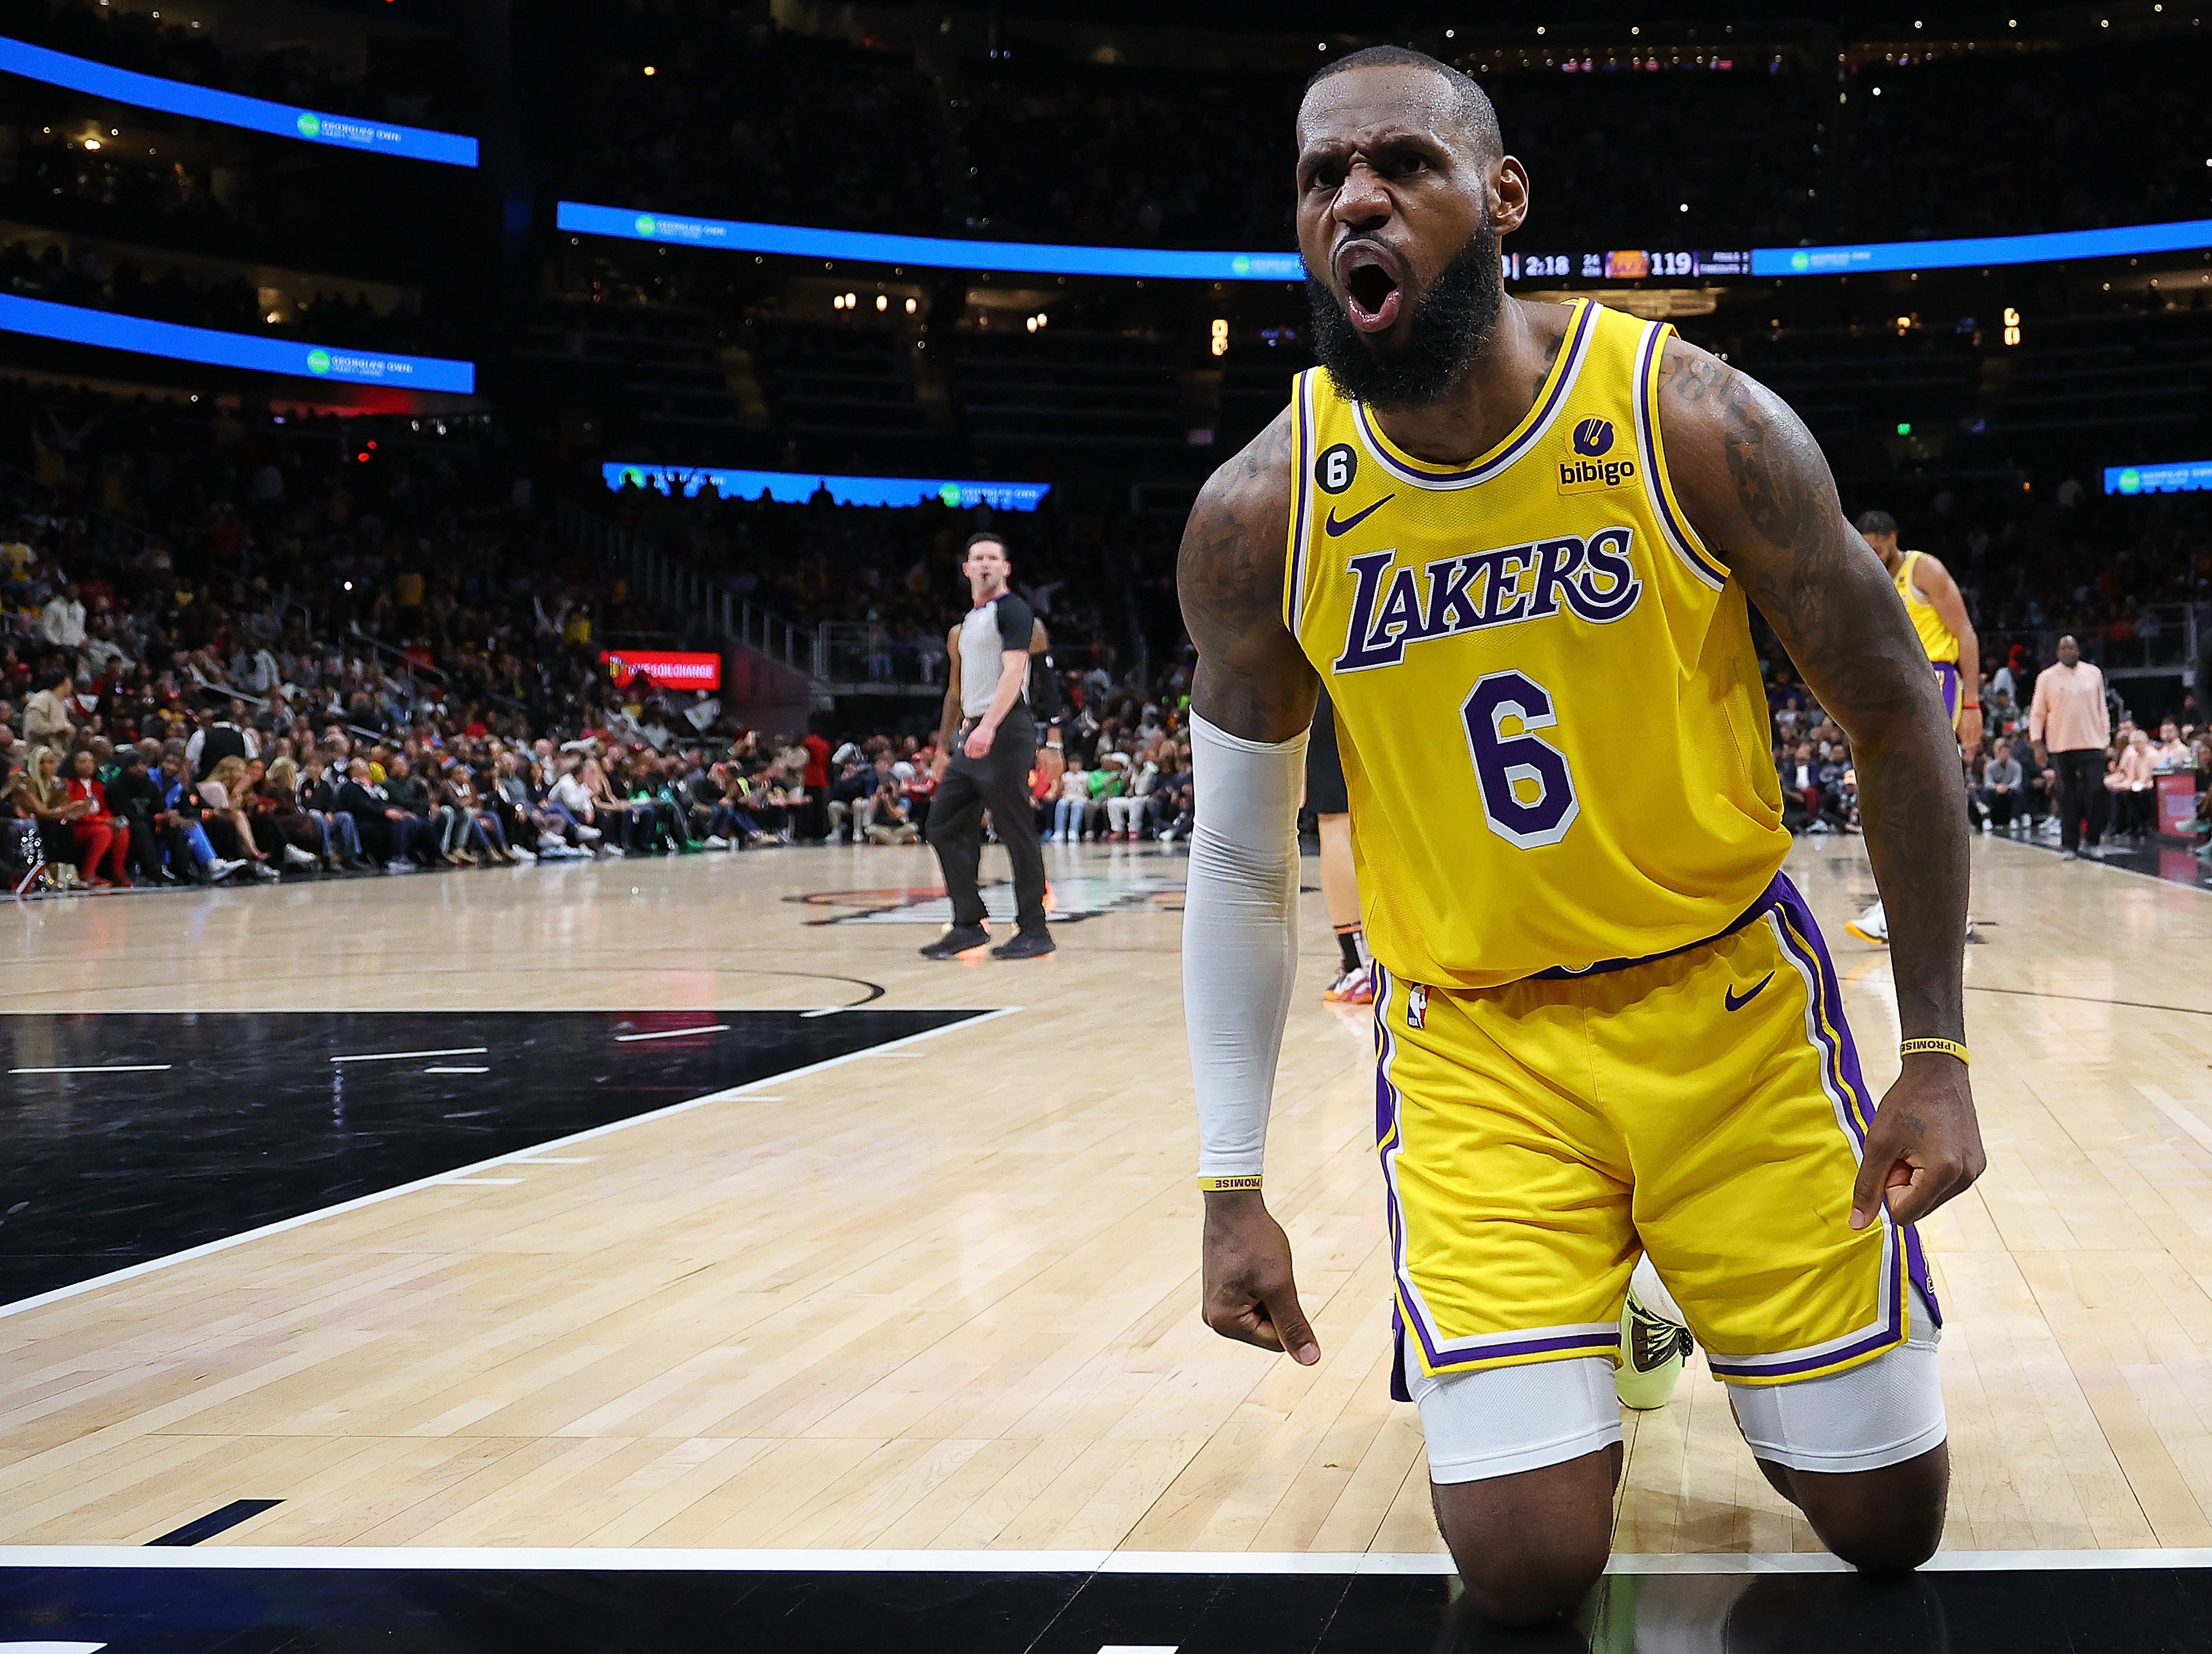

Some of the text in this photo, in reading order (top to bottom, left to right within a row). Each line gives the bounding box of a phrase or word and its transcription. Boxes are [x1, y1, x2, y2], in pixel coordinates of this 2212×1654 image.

[1525, 256, 1570, 276] 2:18
[1651, 252, 1692, 275] 119
[1327, 450, 1347, 487] 6
[1560, 459, 1635, 486] bibigo
[1332, 526, 1642, 674] LAKERS
[1459, 668, 1580, 851] 6
[1901, 1040, 1951, 1052] PROMISE
